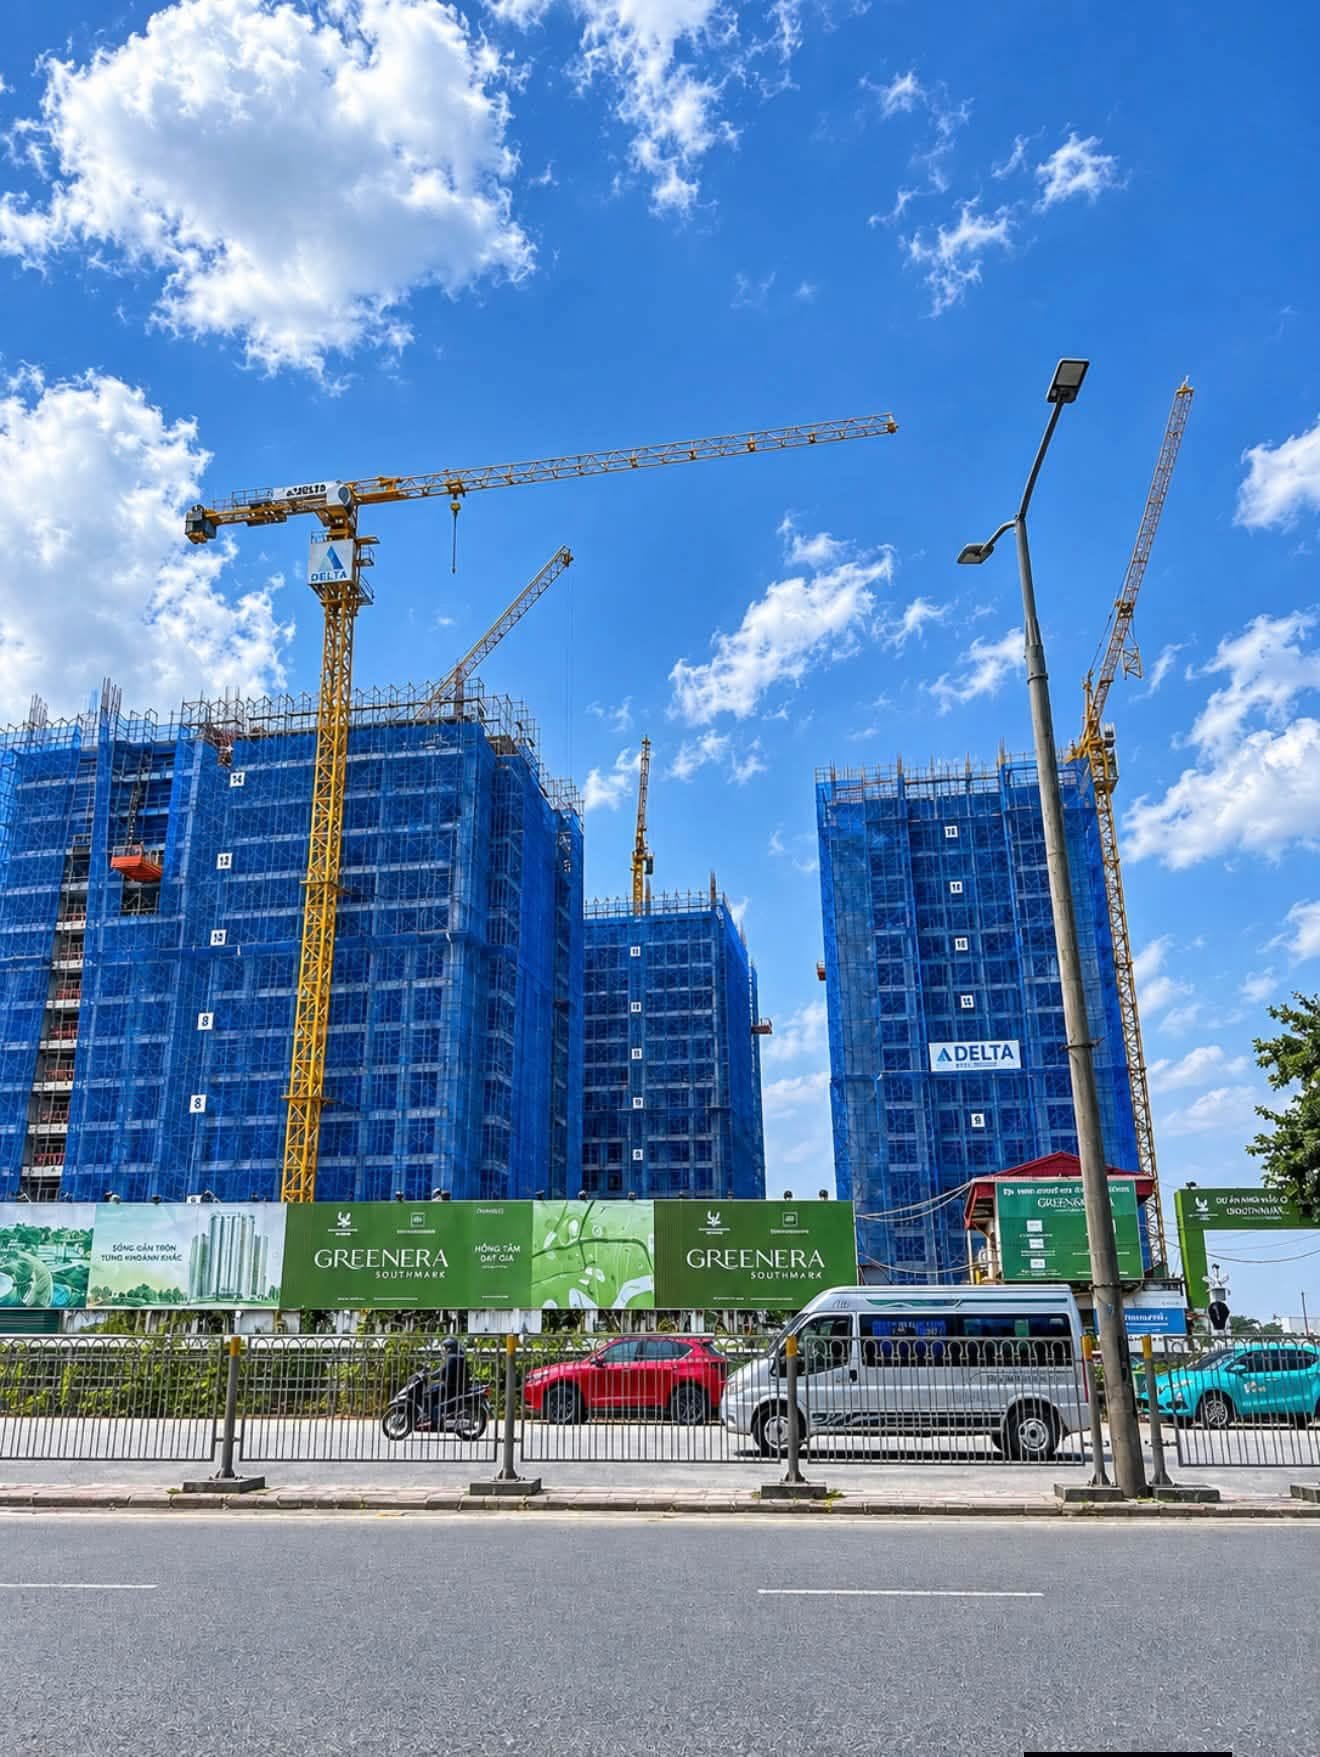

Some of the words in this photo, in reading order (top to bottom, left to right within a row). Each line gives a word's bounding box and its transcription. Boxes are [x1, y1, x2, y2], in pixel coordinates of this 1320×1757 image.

[311, 571, 347, 582] DELTA
[954, 1044, 1014, 1061] DELTA
[314, 1248, 449, 1270] GREENERA
[686, 1248, 825, 1270] GREENERA
[375, 1270, 446, 1279] SOUTHMARK
[750, 1271, 823, 1280] SOUTHMARK
